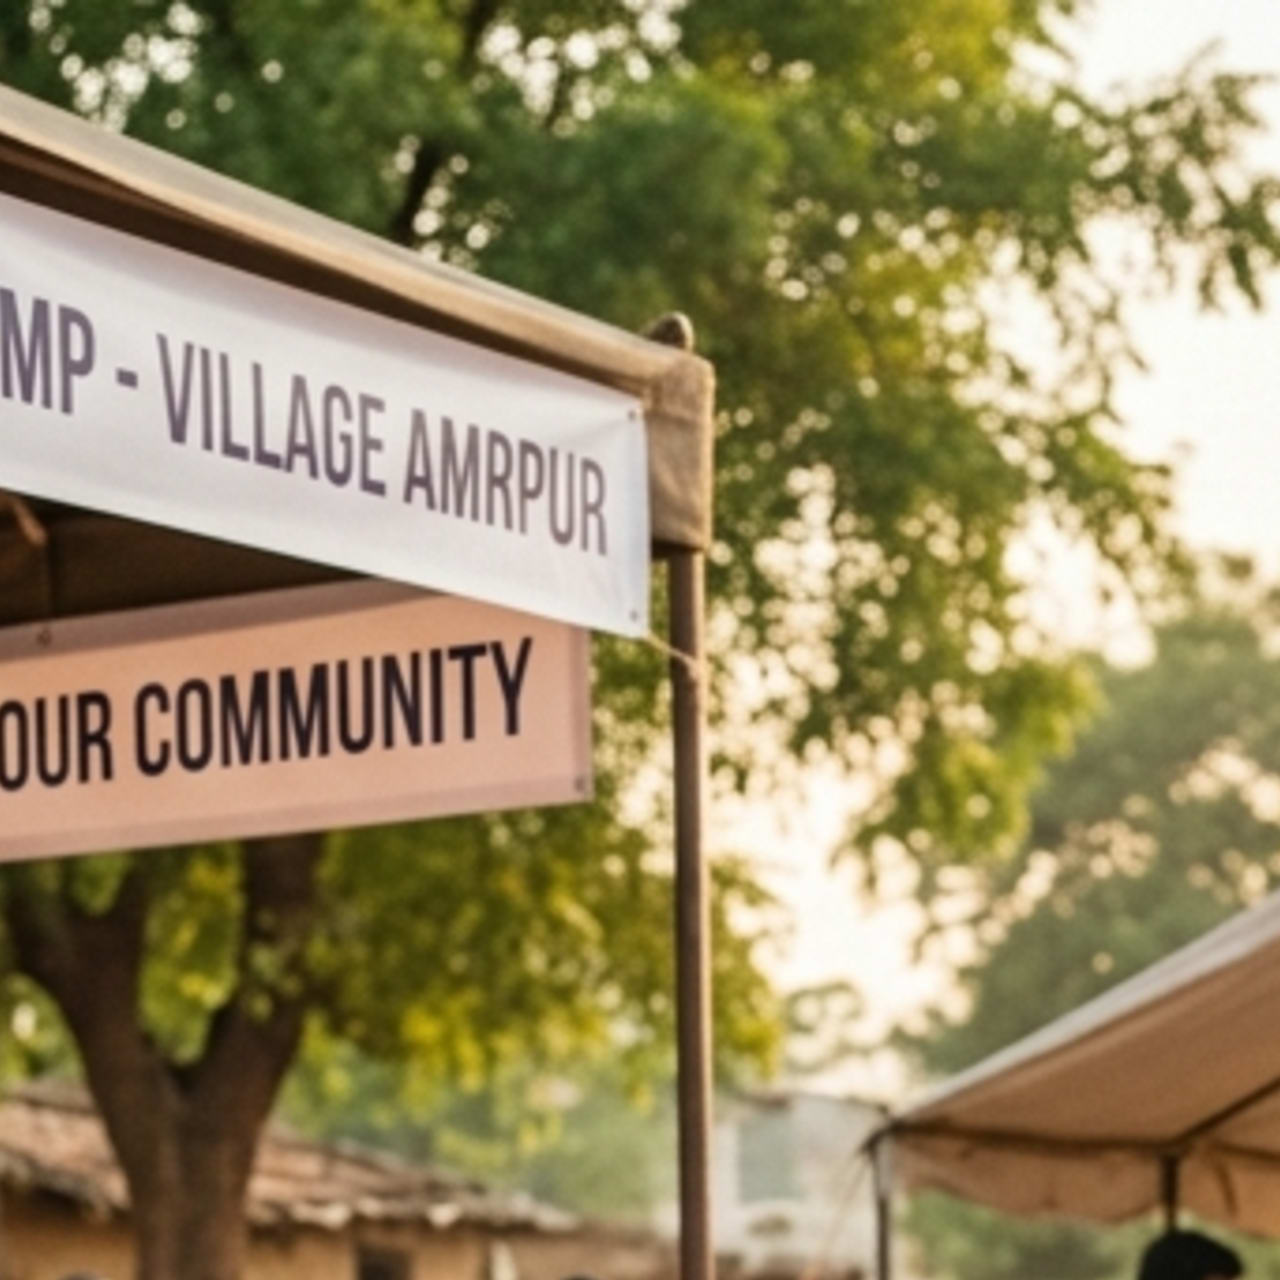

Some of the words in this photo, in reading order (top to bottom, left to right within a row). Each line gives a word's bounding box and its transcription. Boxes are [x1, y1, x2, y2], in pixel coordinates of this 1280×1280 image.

[156, 333, 387, 498] VILLAGE
[402, 408, 608, 556] AMRPUR
[133, 636, 533, 778] COMMUNITY
